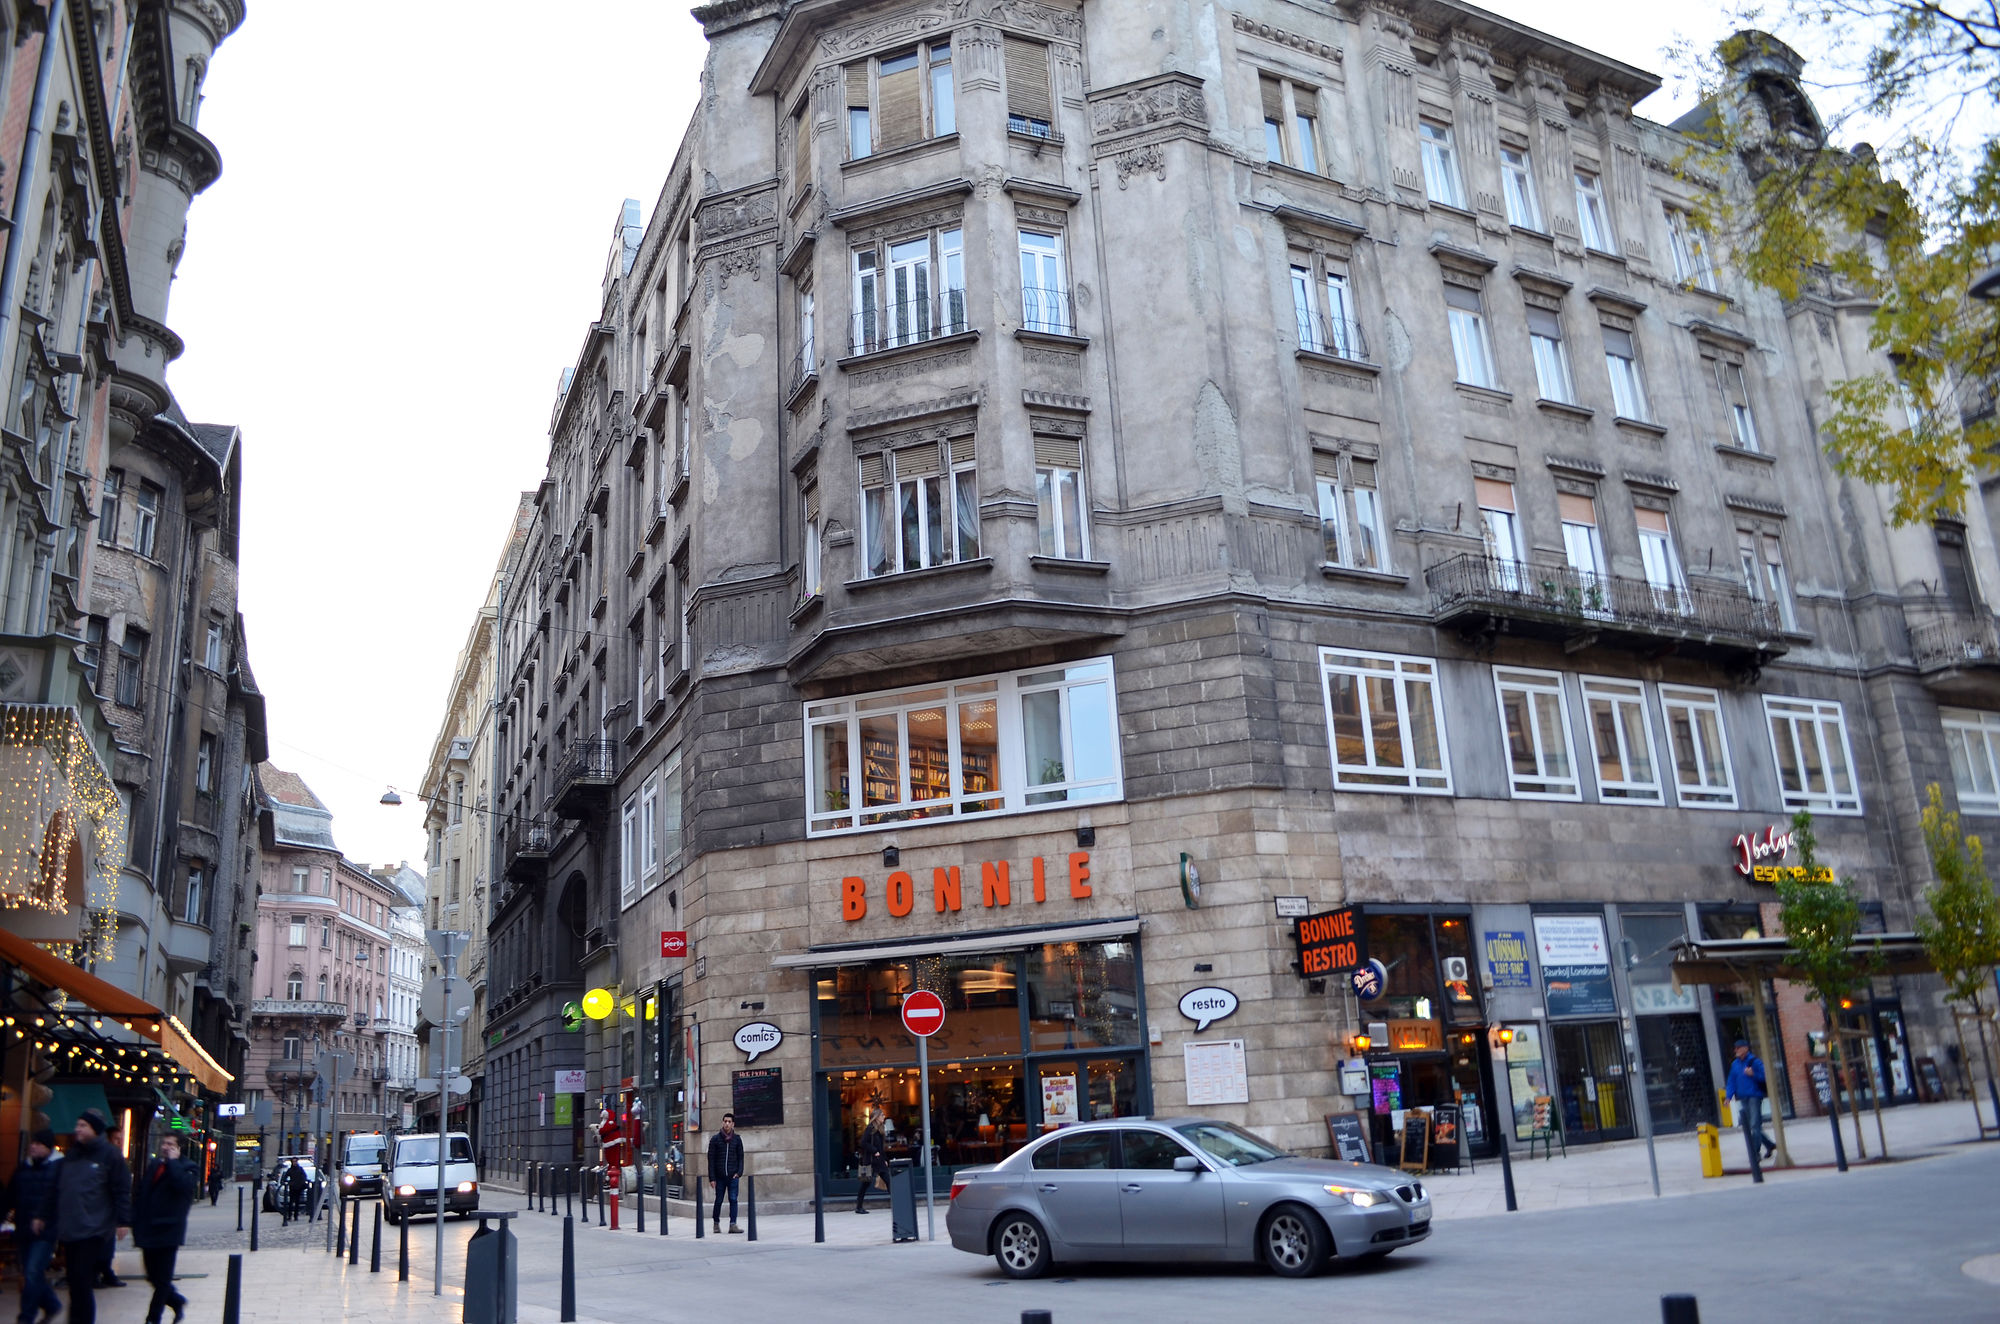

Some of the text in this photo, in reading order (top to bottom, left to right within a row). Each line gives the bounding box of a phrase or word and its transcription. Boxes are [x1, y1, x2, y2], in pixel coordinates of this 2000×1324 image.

[842, 851, 1093, 921] BONNIE
[1300, 911, 1355, 944] BONNIE
[1302, 941, 1357, 974] RESTRO
[1192, 997, 1226, 1010] restro
[741, 1031, 775, 1043] comics
[1392, 1026, 1440, 1048] KELTA
